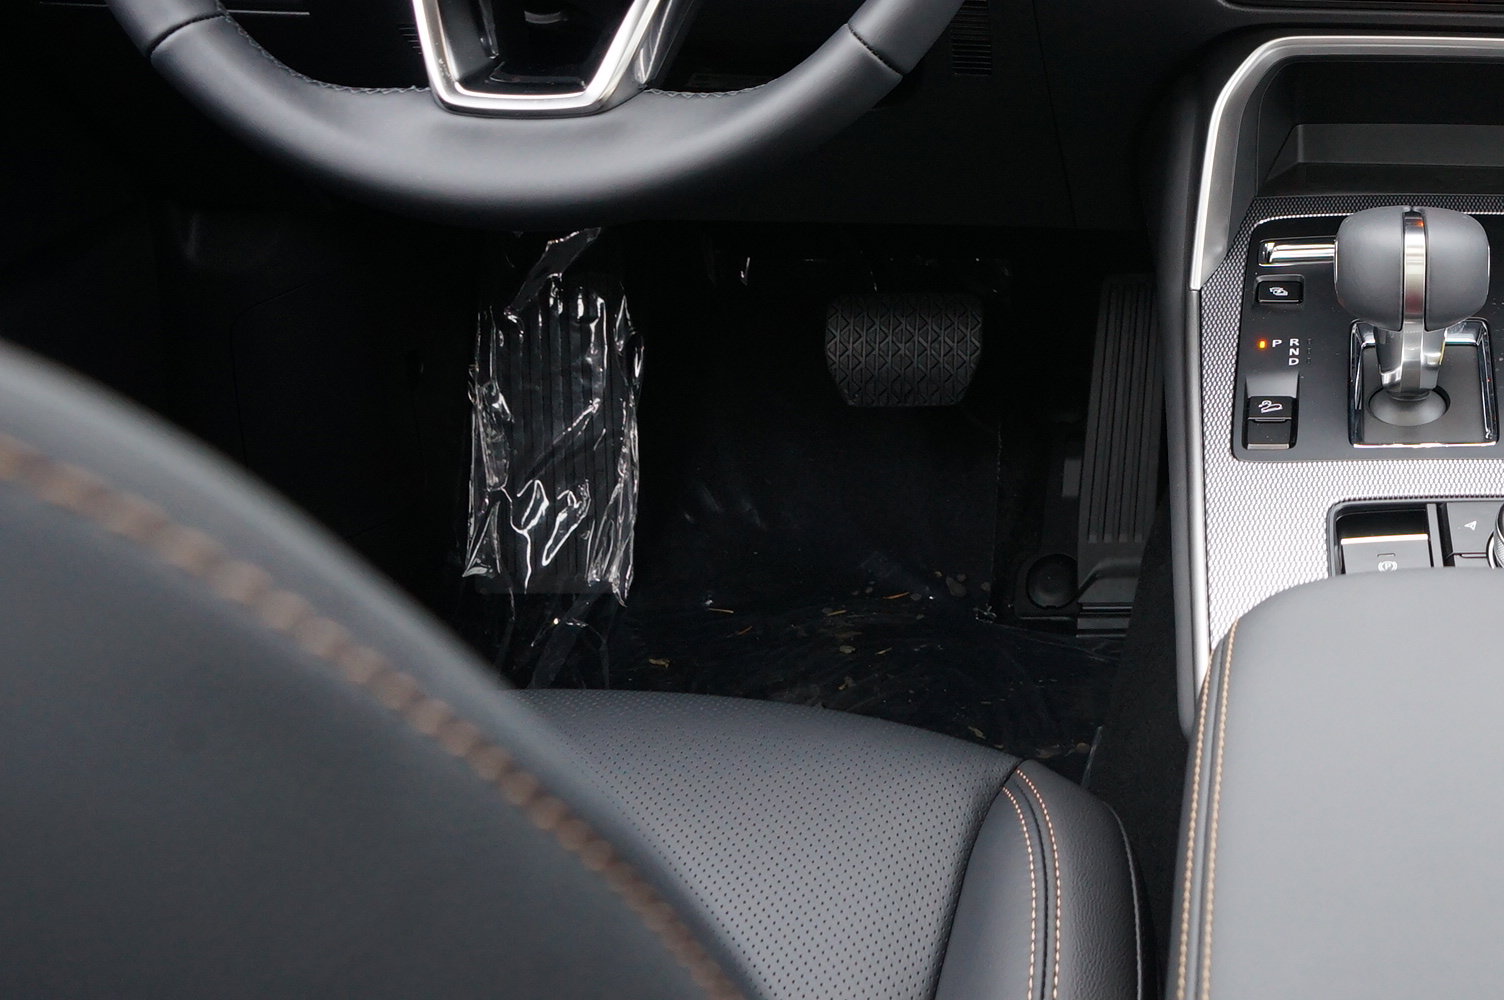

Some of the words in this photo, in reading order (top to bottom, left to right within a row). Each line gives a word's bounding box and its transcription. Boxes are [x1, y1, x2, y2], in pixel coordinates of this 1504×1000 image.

[1272, 339, 1282, 348] P
[1289, 338, 1300, 346] R
[1289, 348, 1300, 356] N
[1288, 358, 1300, 366] D
